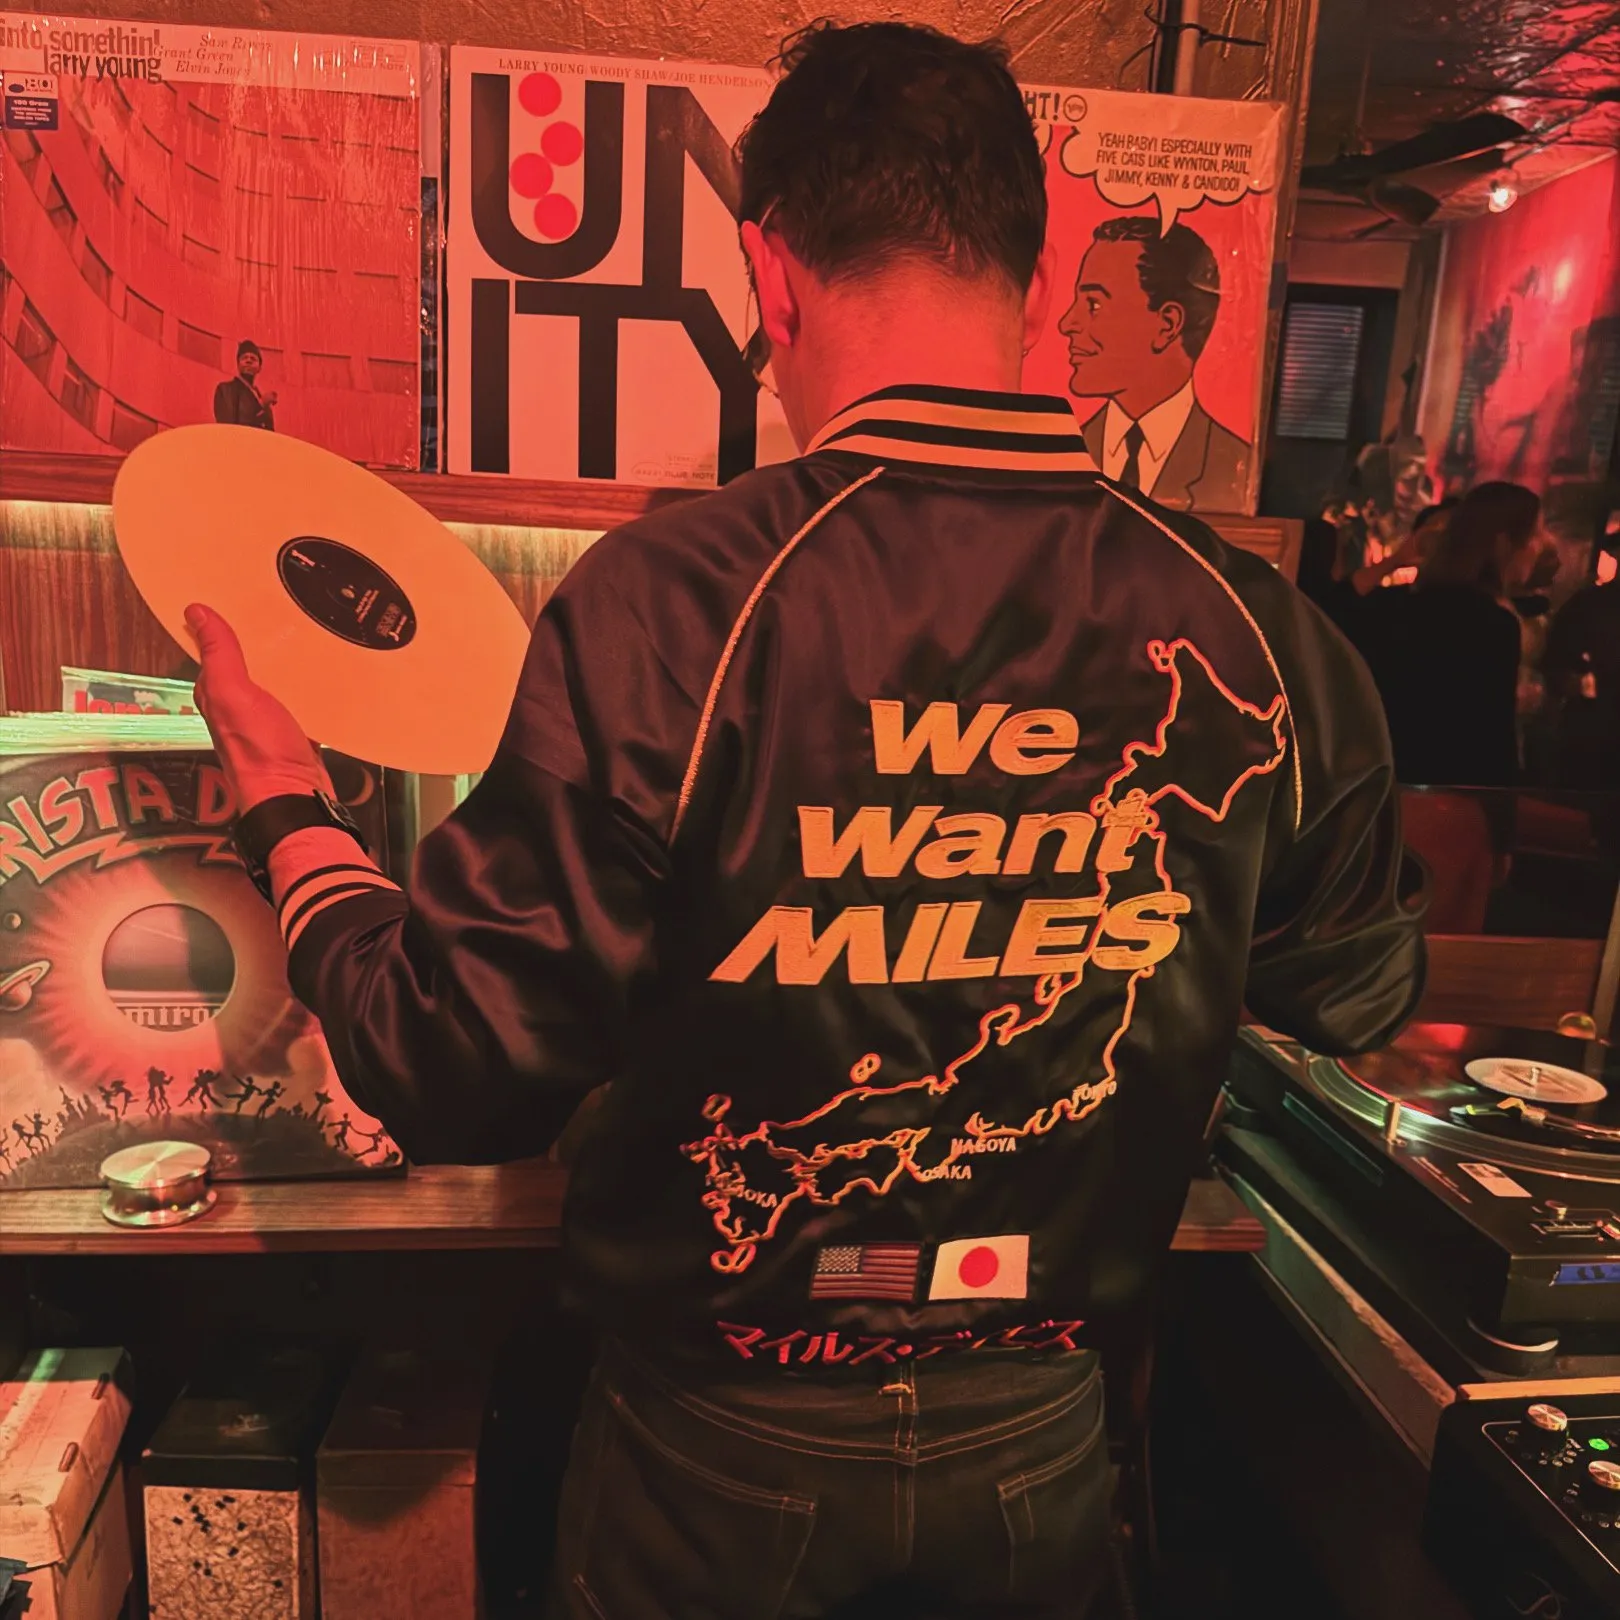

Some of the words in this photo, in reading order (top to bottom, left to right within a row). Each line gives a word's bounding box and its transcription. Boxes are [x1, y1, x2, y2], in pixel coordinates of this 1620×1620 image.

[50, 27, 160, 56] somethin!
[43, 44, 91, 82] larry
[96, 56, 162, 83] young
[176, 60, 210, 74] Elvin
[499, 58, 538, 72] LARRY
[700, 74, 773, 90] HENDERSON
[1096, 149, 1118, 165] FIVE
[1121, 151, 1146, 168] CATS
[1148, 154, 1171, 169] LIKE
[1098, 132, 1126, 148] YEAH
[1160, 137, 1222, 156] ESPECIALLY
[1224, 142, 1253, 159] WITH
[1104, 168, 1144, 188] JIMMY,
[1145, 172, 1180, 188] KENNY
[1181, 174, 1190, 189] &
[1193, 176, 1241, 193] CANDIDO!
[869, 699, 1080, 776] We
[797, 800, 1142, 880] Want
[706, 891, 1192, 986] MILES
[951, 1137, 1017, 1154] NAGOYA
